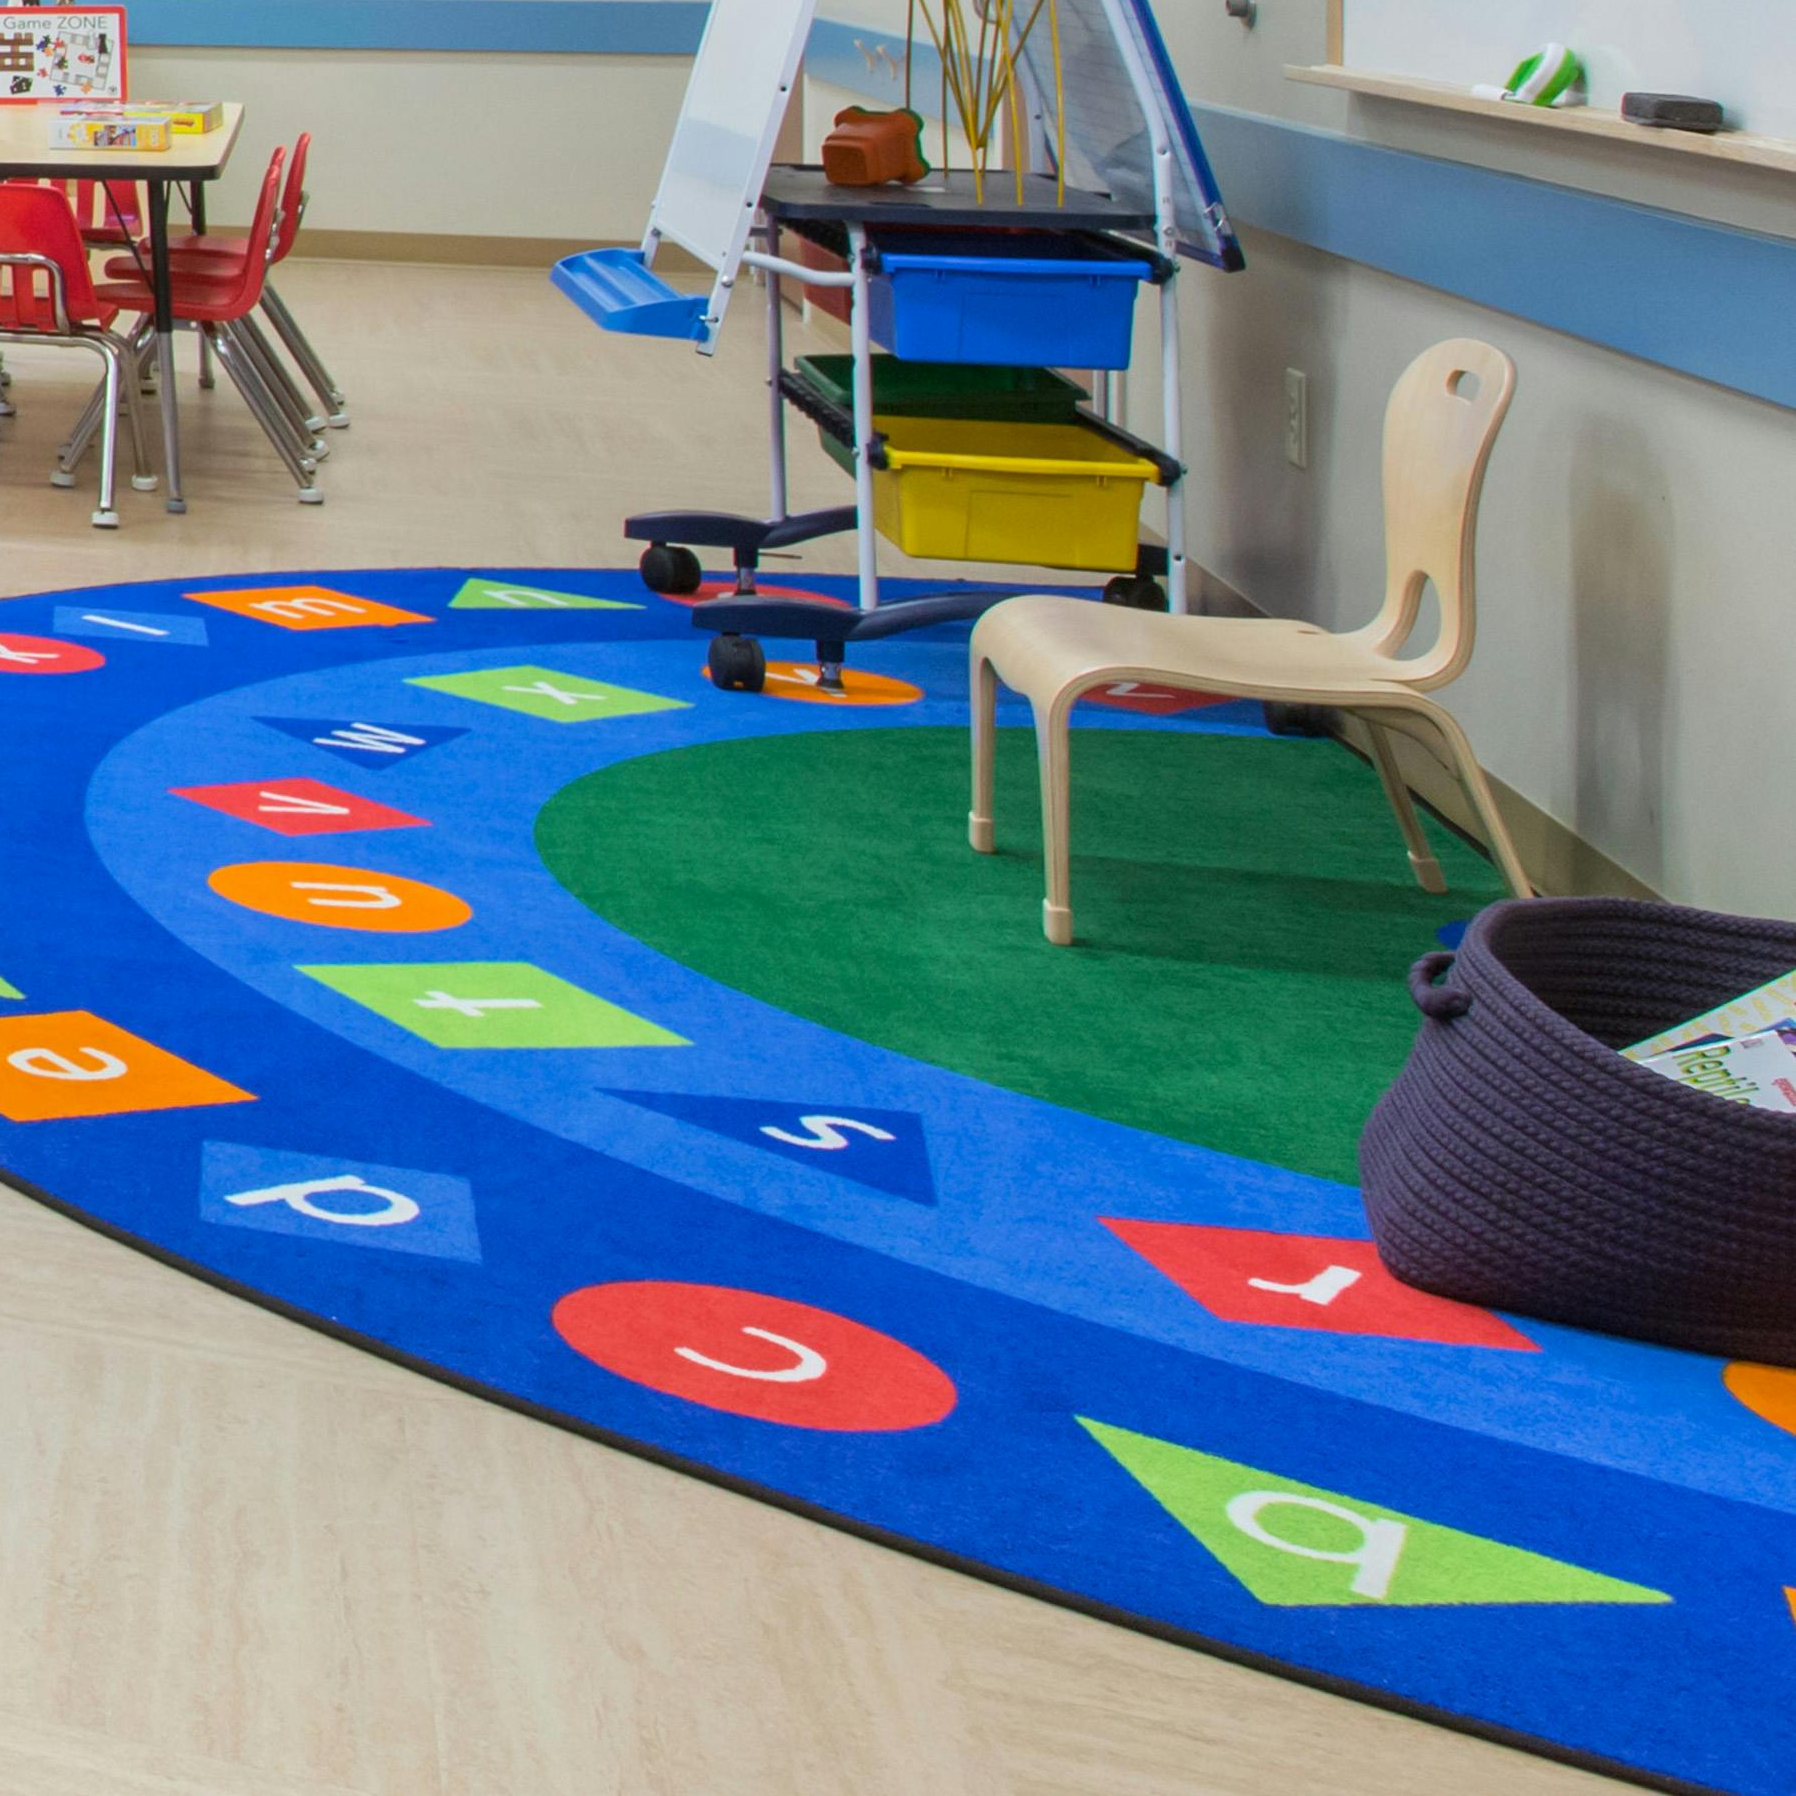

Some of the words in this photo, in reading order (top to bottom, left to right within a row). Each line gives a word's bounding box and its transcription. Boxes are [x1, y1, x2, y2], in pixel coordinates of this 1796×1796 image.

[3, 16, 52, 30] Game
[56, 16, 108, 29] ZONE
[273, 591, 367, 619] m
[503, 681, 606, 707] x
[314, 722, 427, 755] w
[258, 791, 351, 817] v
[411, 989, 543, 1019] t
[7, 1046, 129, 1082] e
[761, 1114, 897, 1150] s
[224, 1174, 422, 1227] d
[1247, 1264, 1363, 1307] r
[672, 1325, 830, 1384] c
